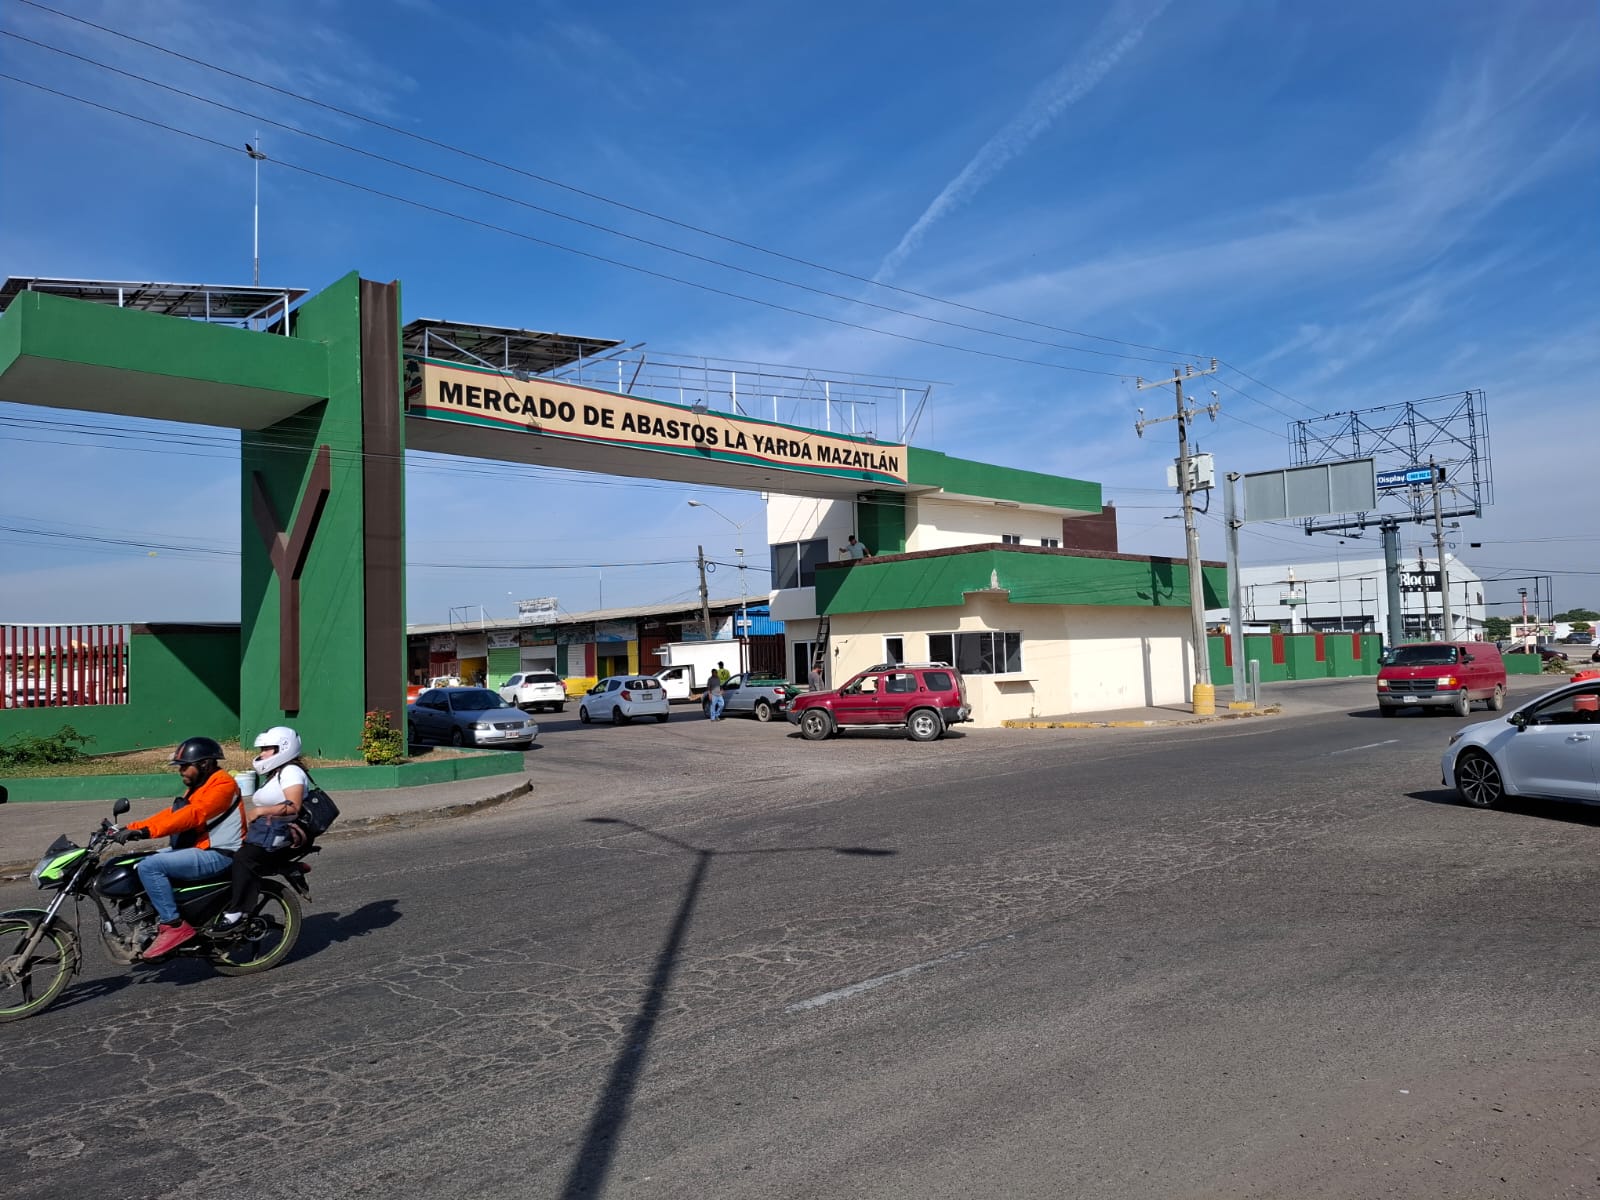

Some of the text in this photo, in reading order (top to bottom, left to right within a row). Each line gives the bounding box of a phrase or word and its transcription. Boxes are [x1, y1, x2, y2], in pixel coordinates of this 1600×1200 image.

[438, 380, 899, 473] MERCADO DE ABASTOS LA YARDA MAZATLÁN
[1378, 474, 1405, 483] Display
